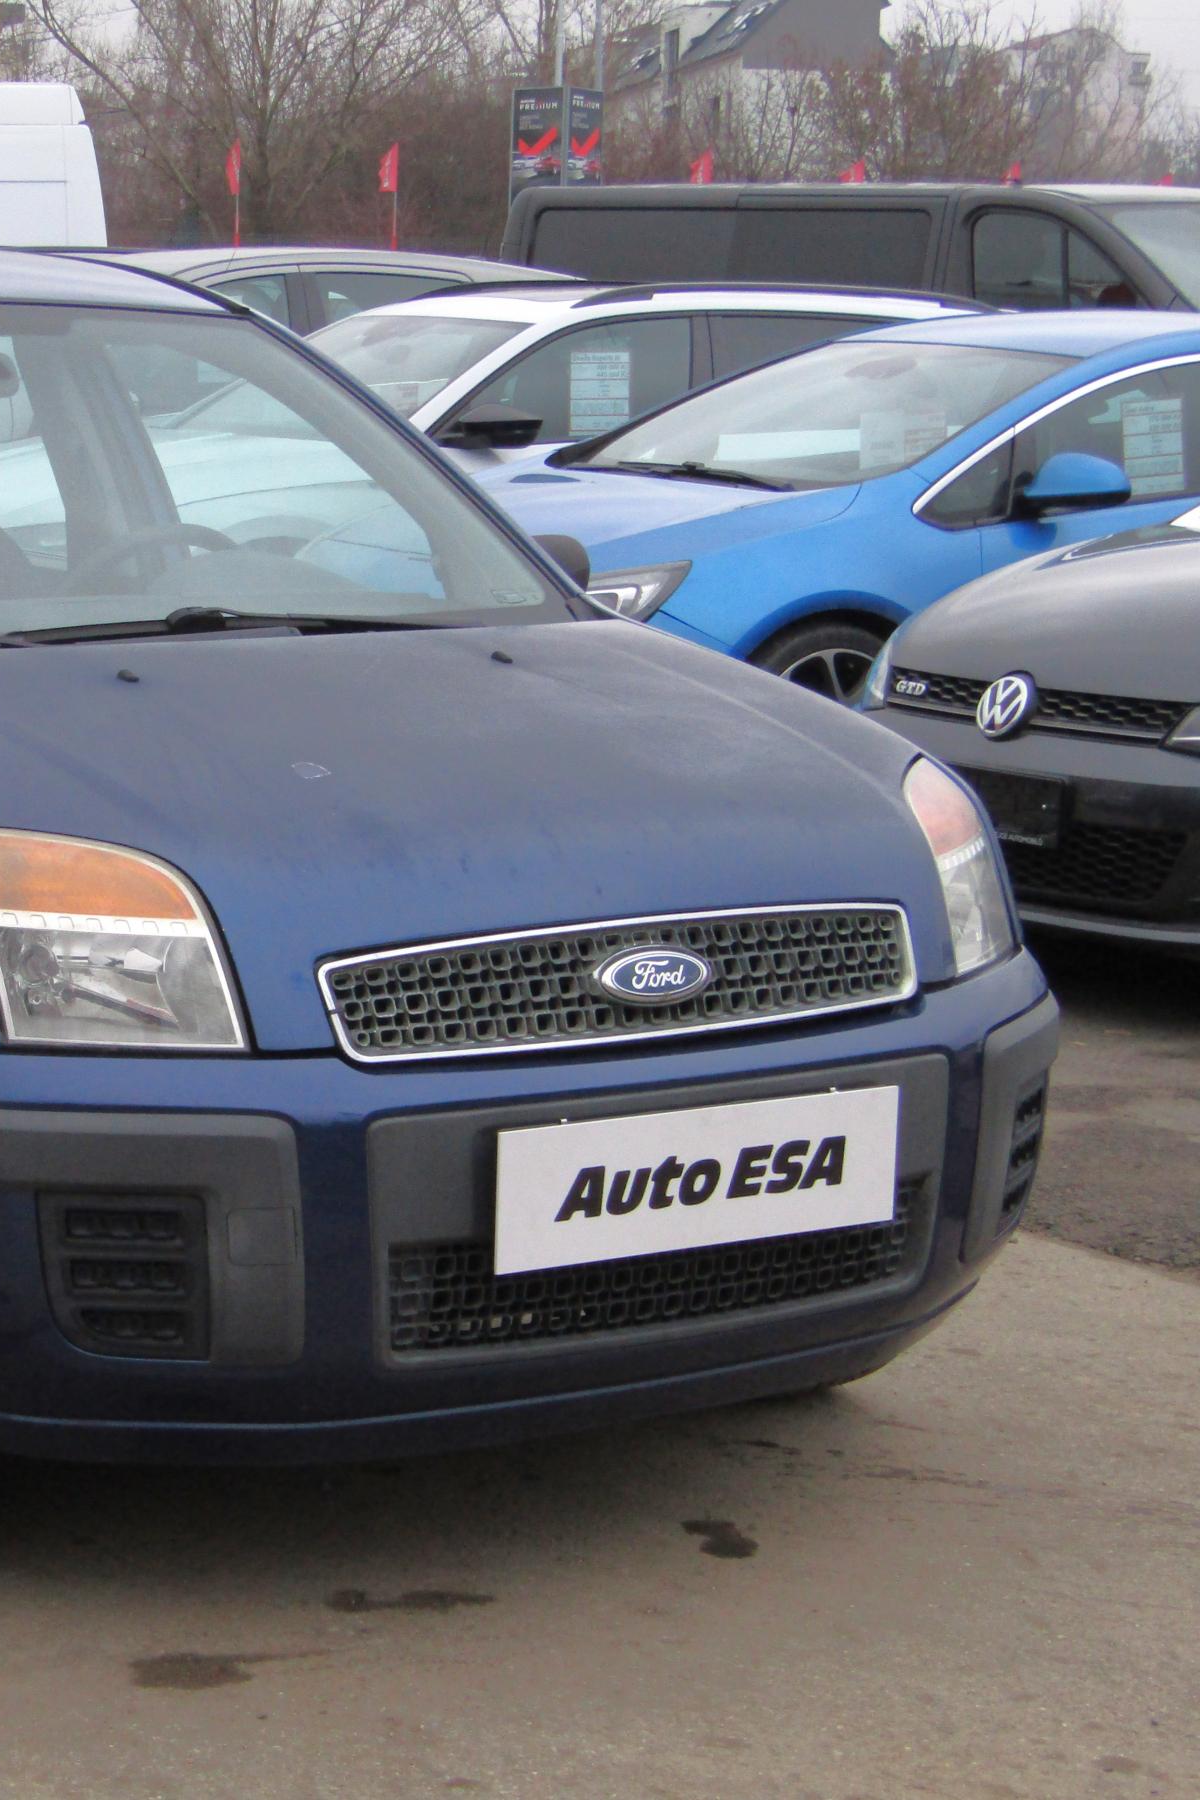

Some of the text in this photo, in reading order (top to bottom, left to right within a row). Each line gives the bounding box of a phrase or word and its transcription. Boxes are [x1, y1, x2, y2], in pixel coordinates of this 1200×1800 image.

[895, 680, 927, 696] GTD
[632, 959, 686, 990] Ford
[553, 1135, 847, 1223] Auto ESA
